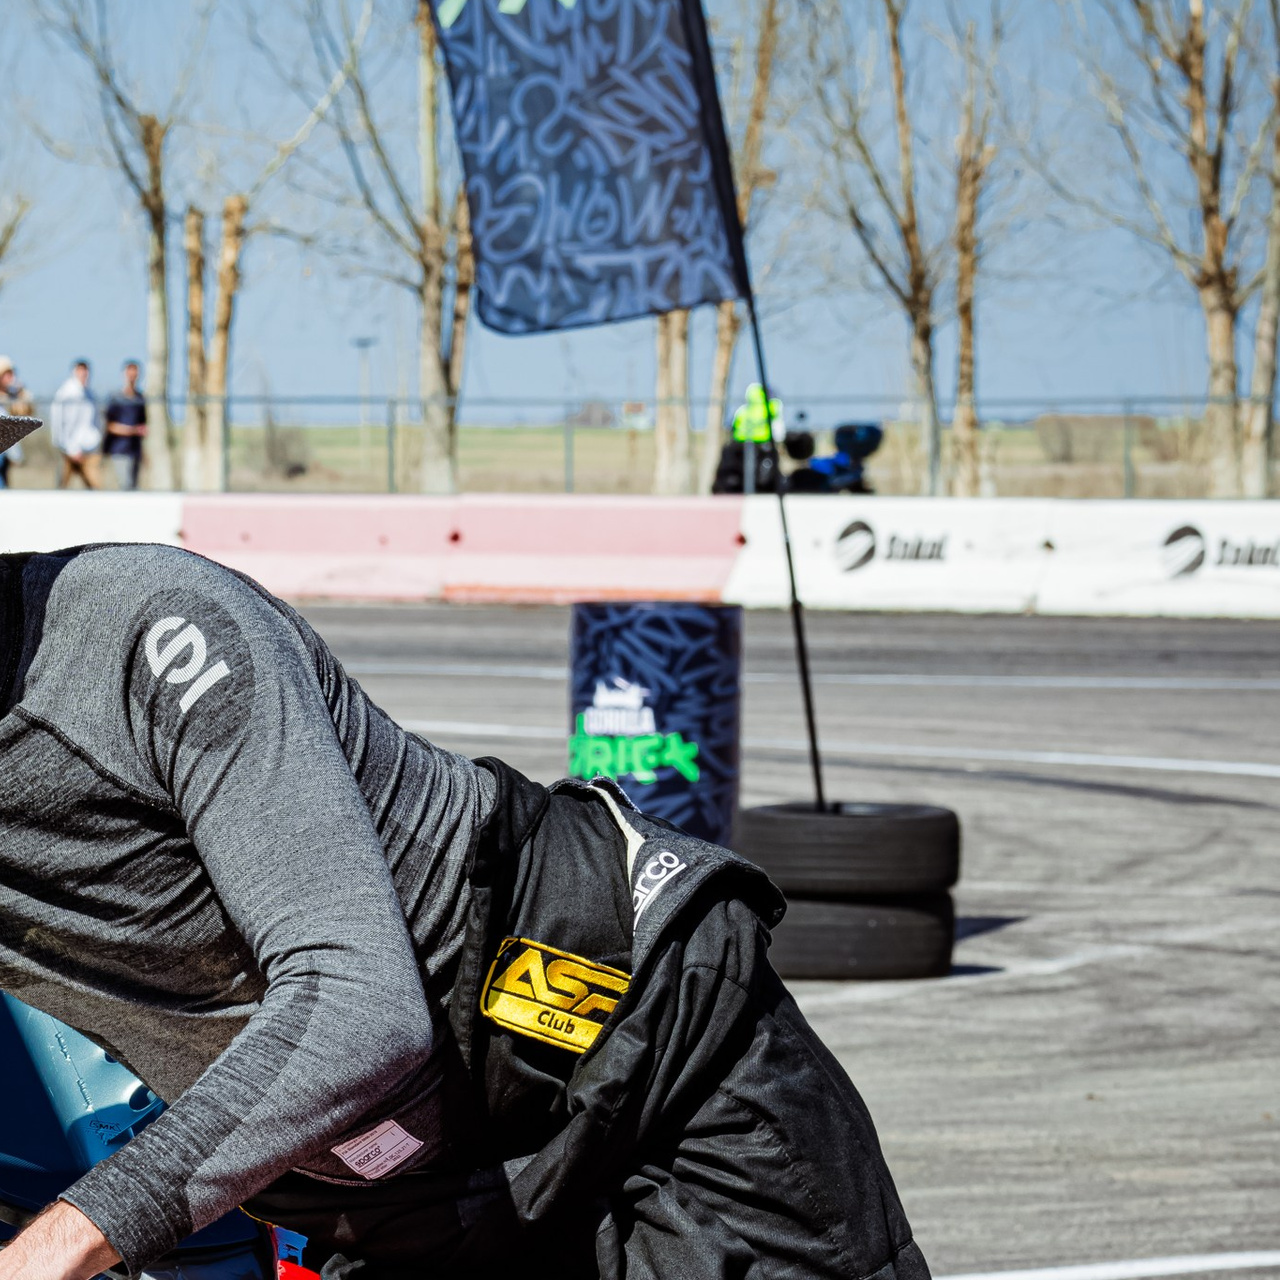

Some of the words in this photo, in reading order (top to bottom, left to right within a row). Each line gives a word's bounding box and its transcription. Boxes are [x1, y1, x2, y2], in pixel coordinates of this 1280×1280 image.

[632, 852, 680, 912] arco
[537, 1011, 576, 1035] Club
[353, 1146, 382, 1167] sparco
